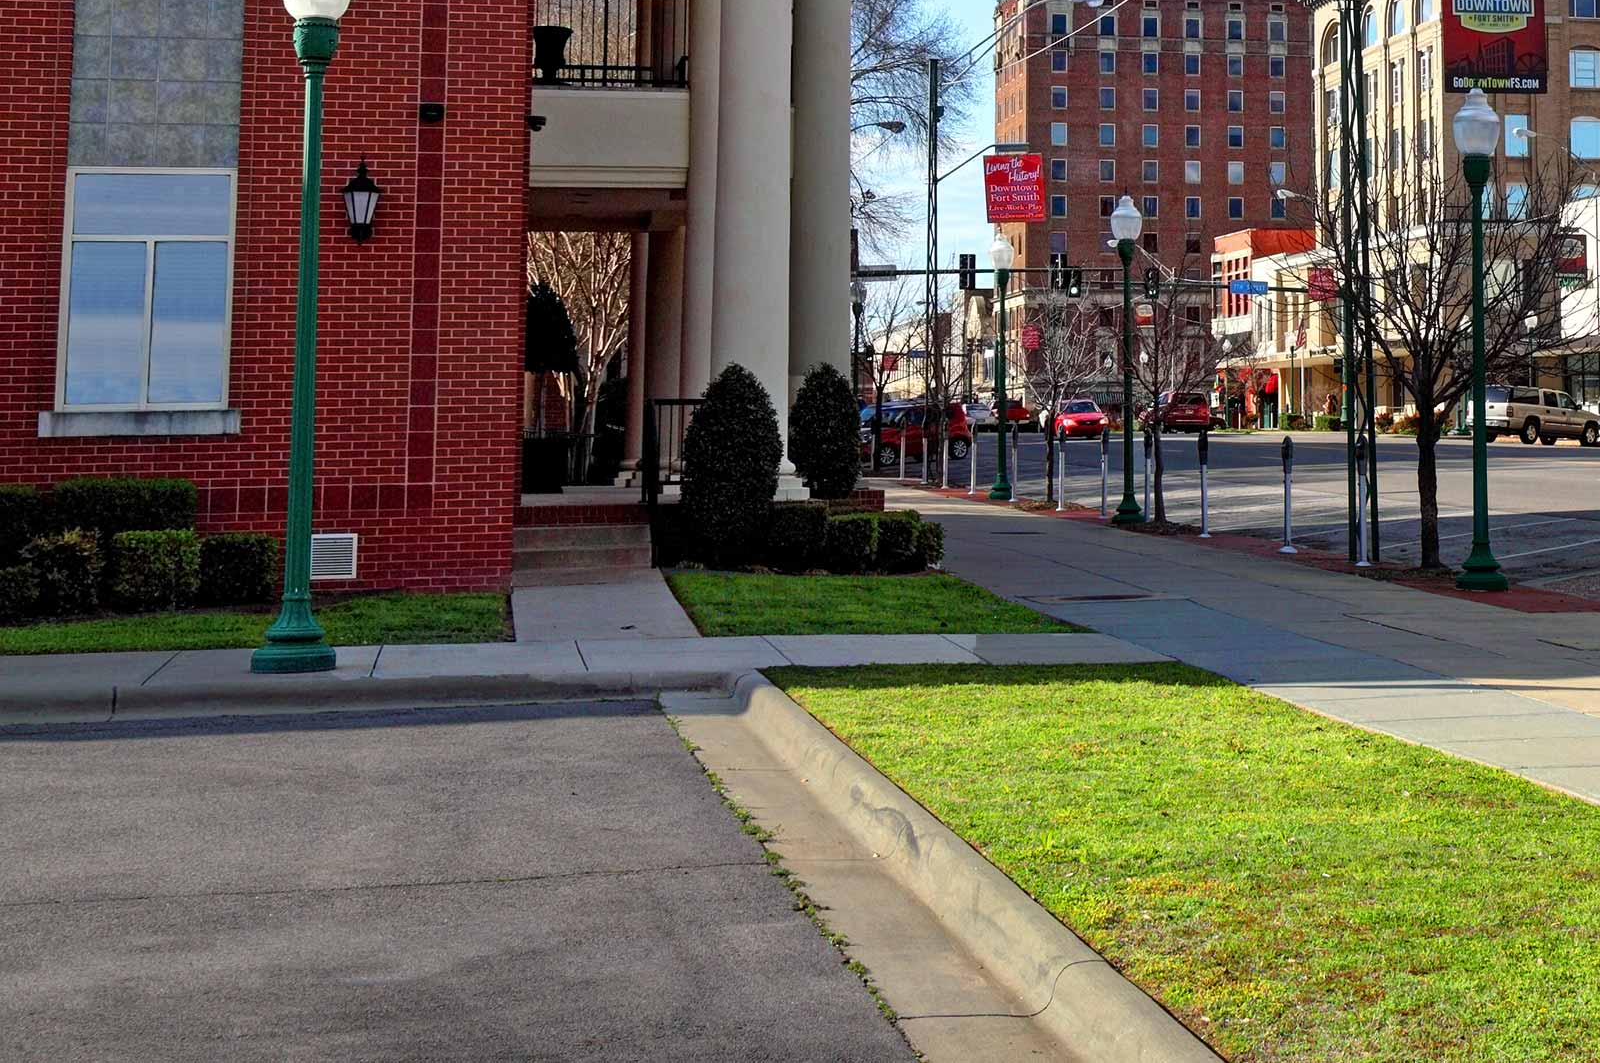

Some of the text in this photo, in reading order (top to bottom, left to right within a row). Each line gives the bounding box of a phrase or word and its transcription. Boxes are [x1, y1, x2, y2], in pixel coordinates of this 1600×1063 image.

[1473, 14, 1514, 24] FORT SMITH
[985, 156, 1025, 176] Living the
[1008, 164, 1041, 184] History!
[990, 184, 1040, 193] Downtown
[990, 192, 1041, 203] Fort Smith
